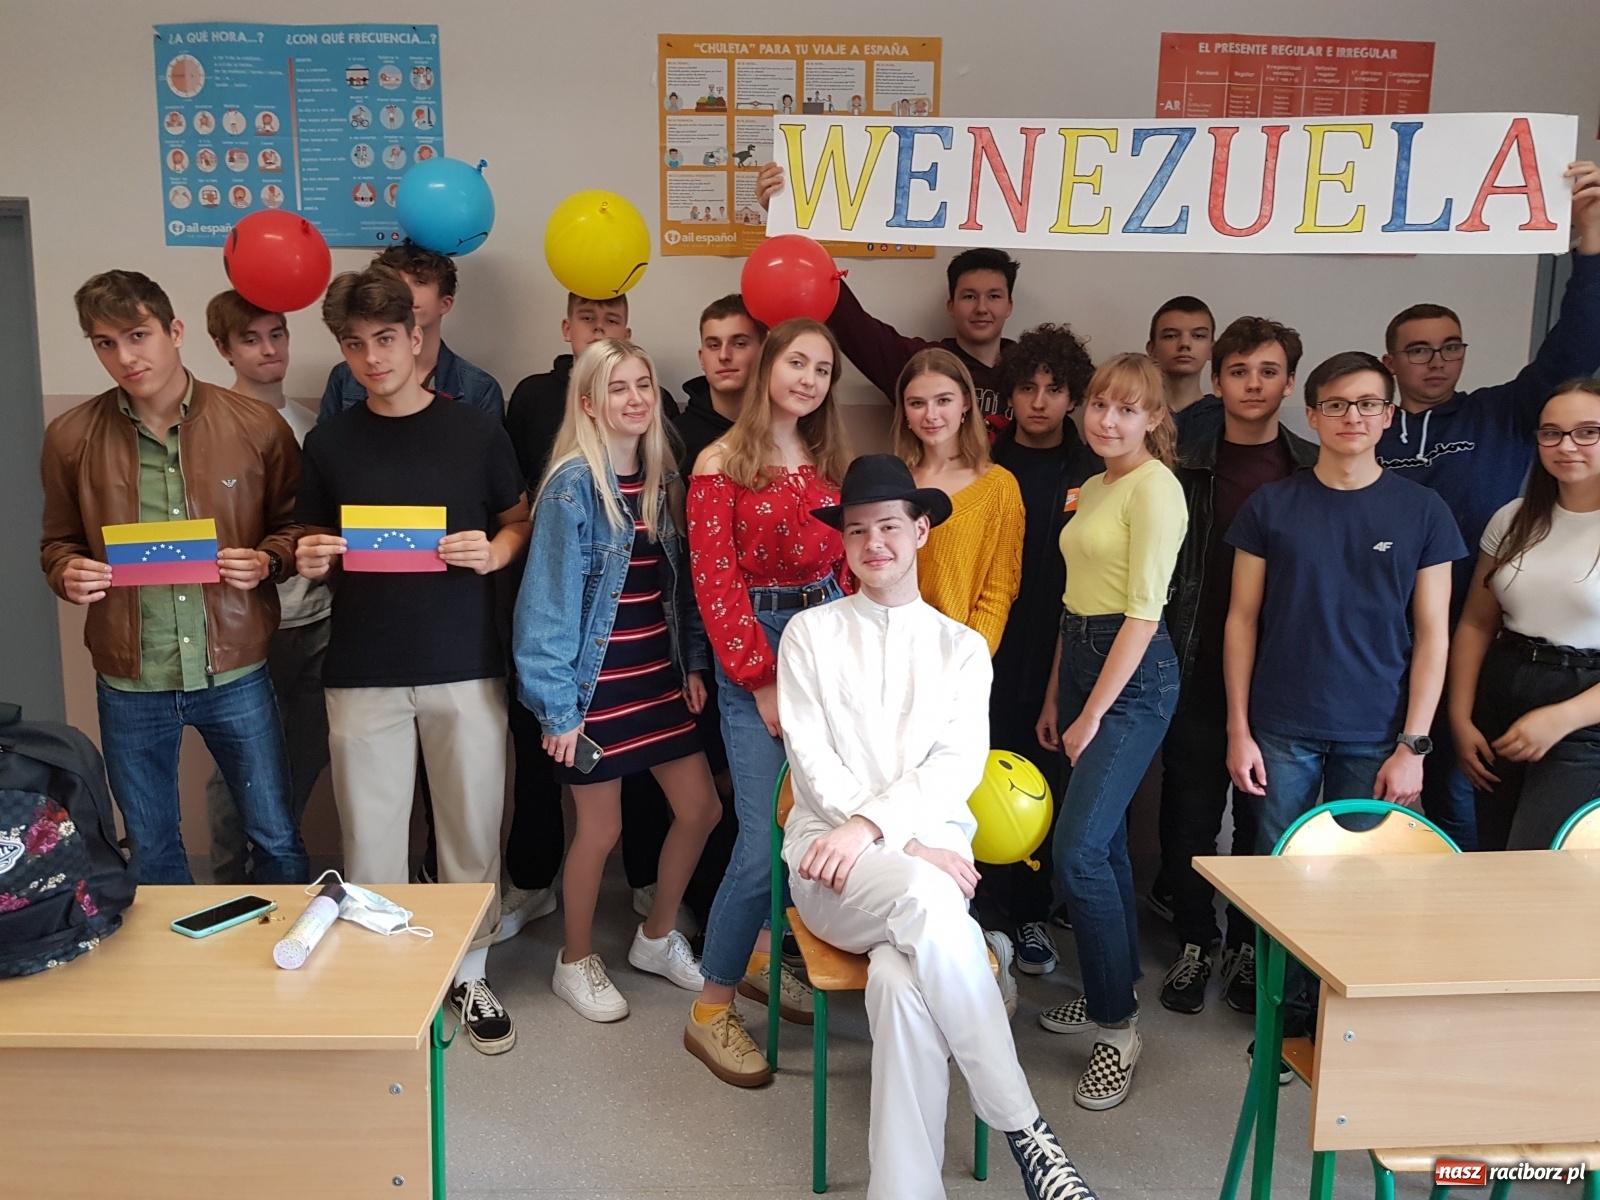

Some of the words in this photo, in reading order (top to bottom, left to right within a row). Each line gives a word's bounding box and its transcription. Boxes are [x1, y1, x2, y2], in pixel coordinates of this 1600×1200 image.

[187, 30, 208, 44] QUÉ
[286, 34, 317, 45] ¿CON
[321, 31, 345, 45] QUÉ
[759, 44, 791, 55] PARA
[795, 44, 808, 55] TU
[812, 44, 846, 55] VIAJE
[850, 45, 860, 55] A
[864, 42, 910, 56] ESPAÑA
[1198, 42, 1211, 54] EL
[1214, 42, 1268, 55] PRESENTE
[1271, 44, 1323, 57] REGULAR
[1326, 46, 1333, 57] E
[1336, 47, 1397, 59] IRREGULAR
[778, 117, 1558, 237] WENEZUELA
[200, 222, 233, 235] españ
[695, 232, 737, 245] español
[1372, 541, 1394, 552] 4F
